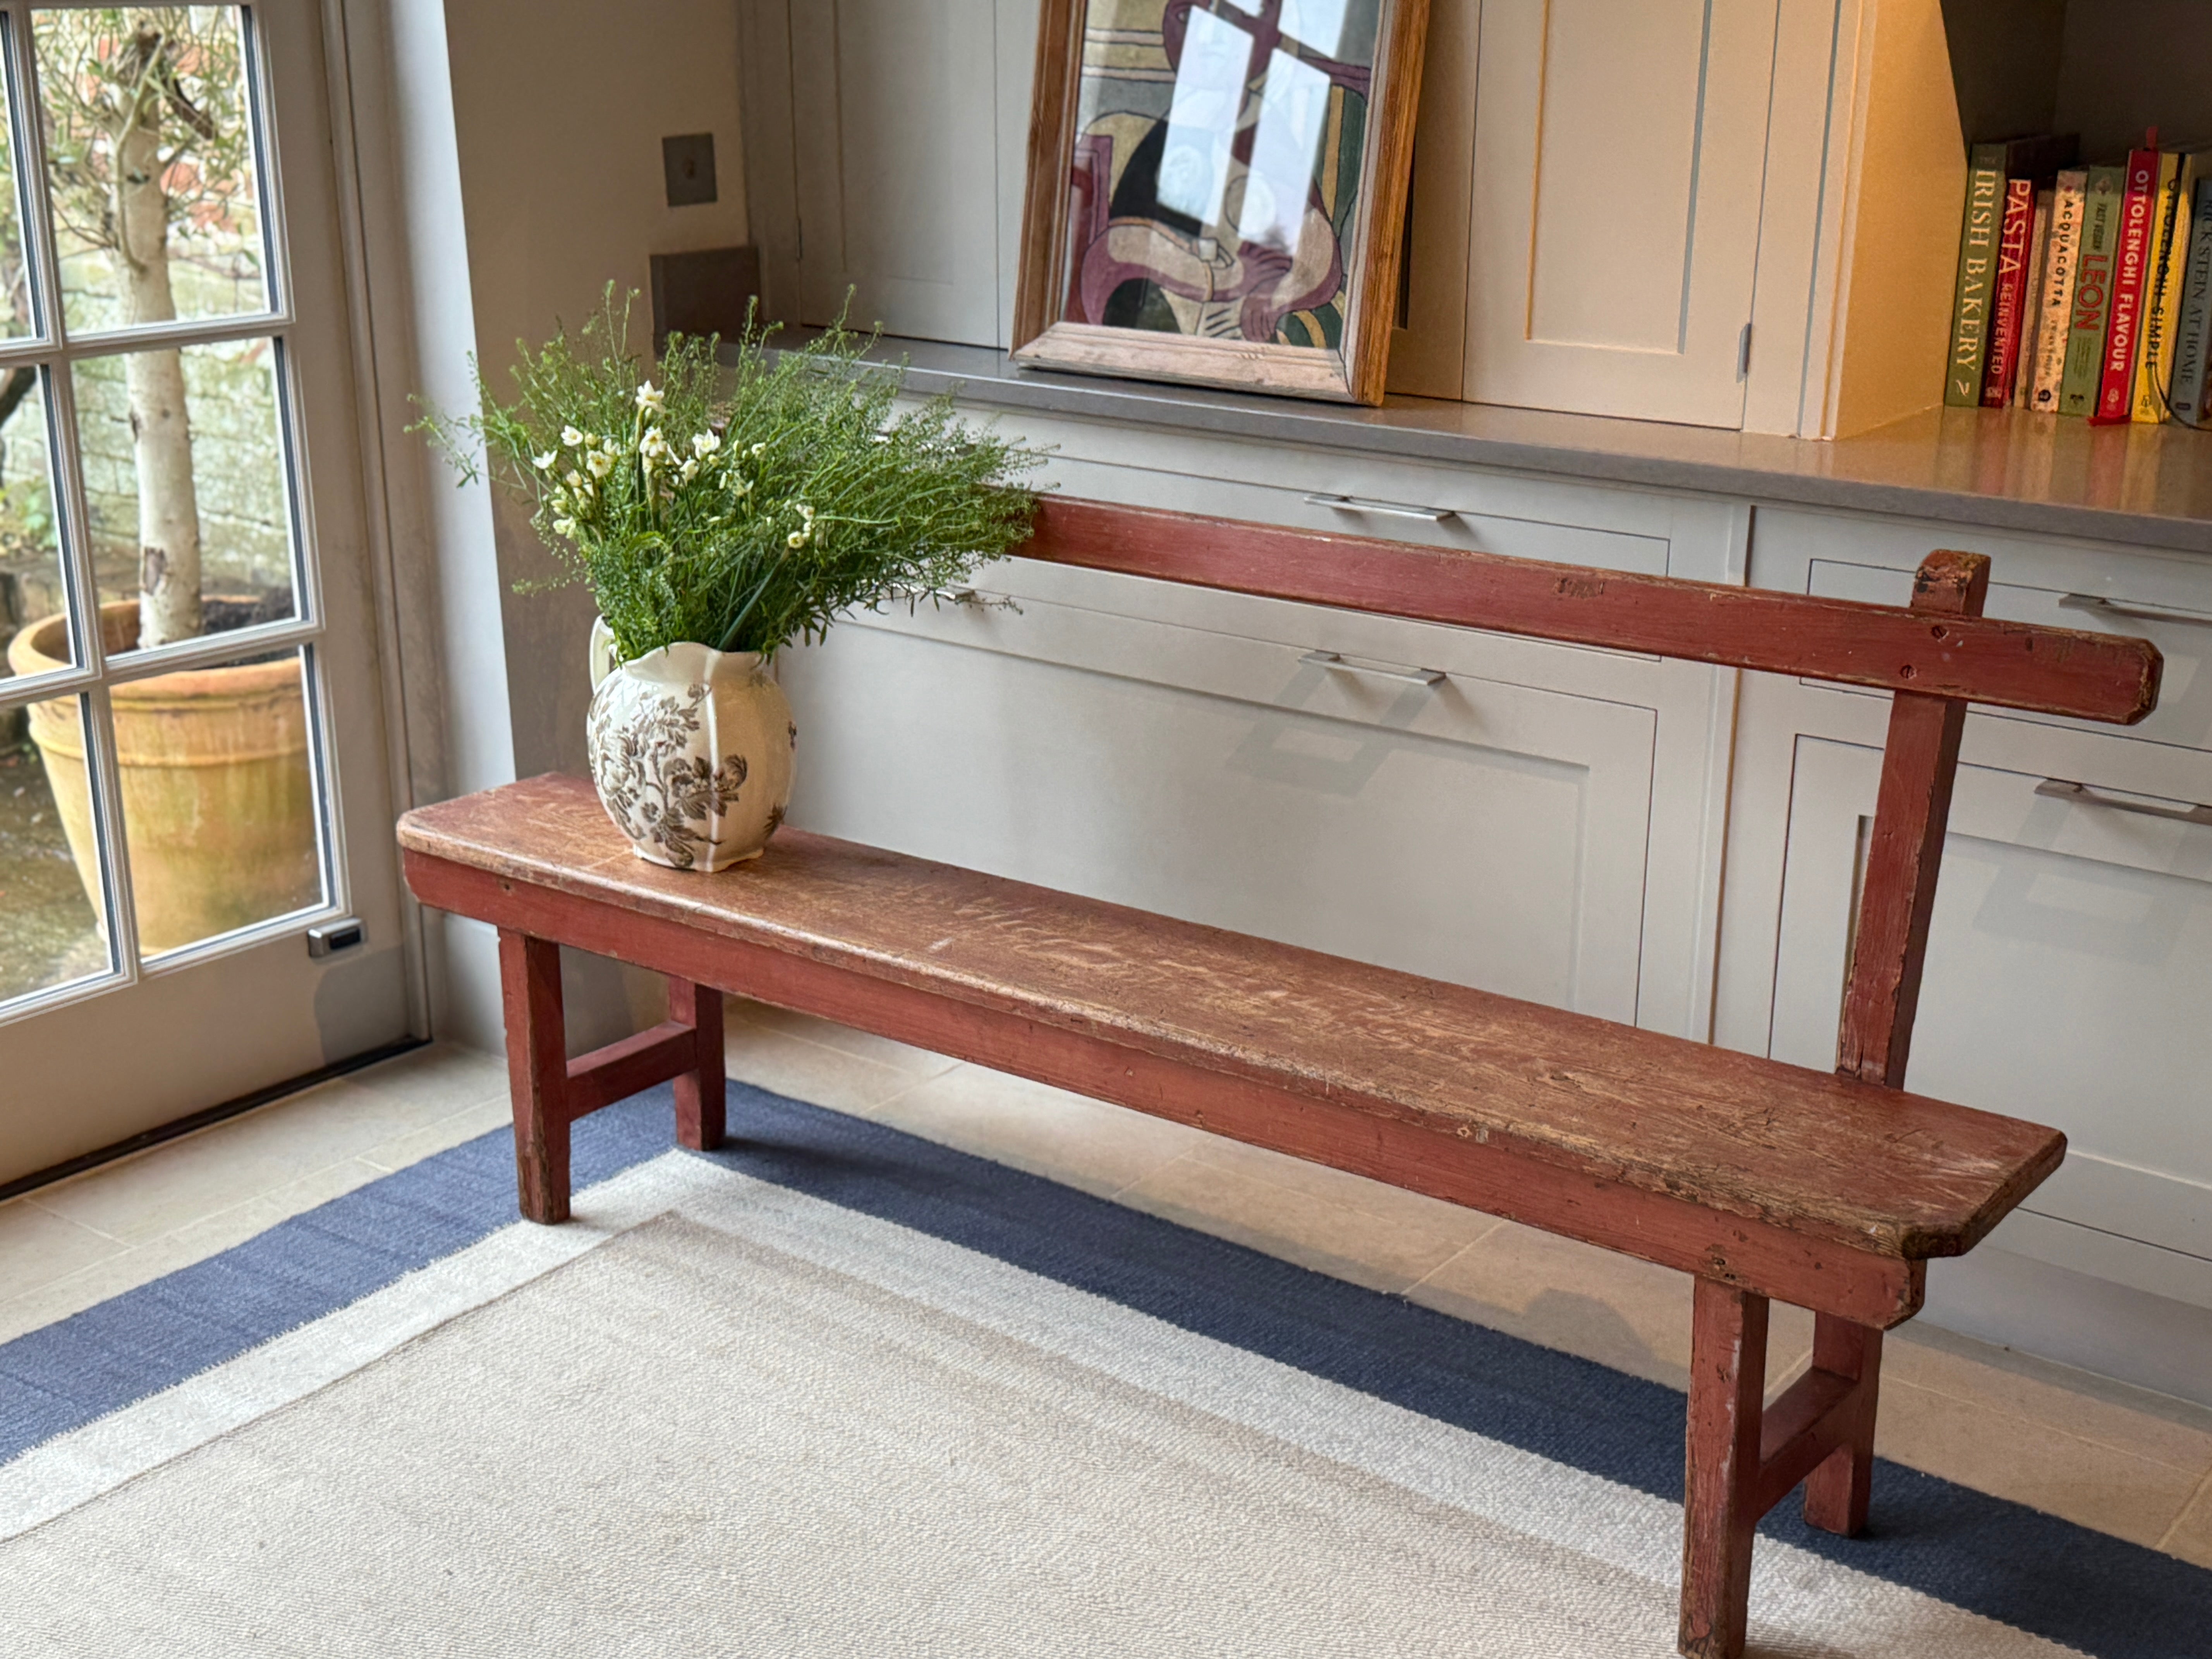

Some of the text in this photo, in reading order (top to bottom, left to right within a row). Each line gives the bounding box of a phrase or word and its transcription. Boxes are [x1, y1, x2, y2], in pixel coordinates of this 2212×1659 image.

[1969, 170, 1996, 247] IRISH
[1991, 179, 2031, 375] PASTA REINVENTED
[2051, 199, 2073, 306] ACQUACOTTA
[2111, 170, 2149, 371] OTTOLENGHI FLAVOUR
[2193, 244, 2210, 301] STEIN
[1956, 258, 1988, 371] BAKERY
[2075, 254, 2108, 331] LEON
[2189, 309, 2203, 327] AT
[2145, 307, 2165, 370] SIMPLE
[2181, 332, 2199, 384] HOME
